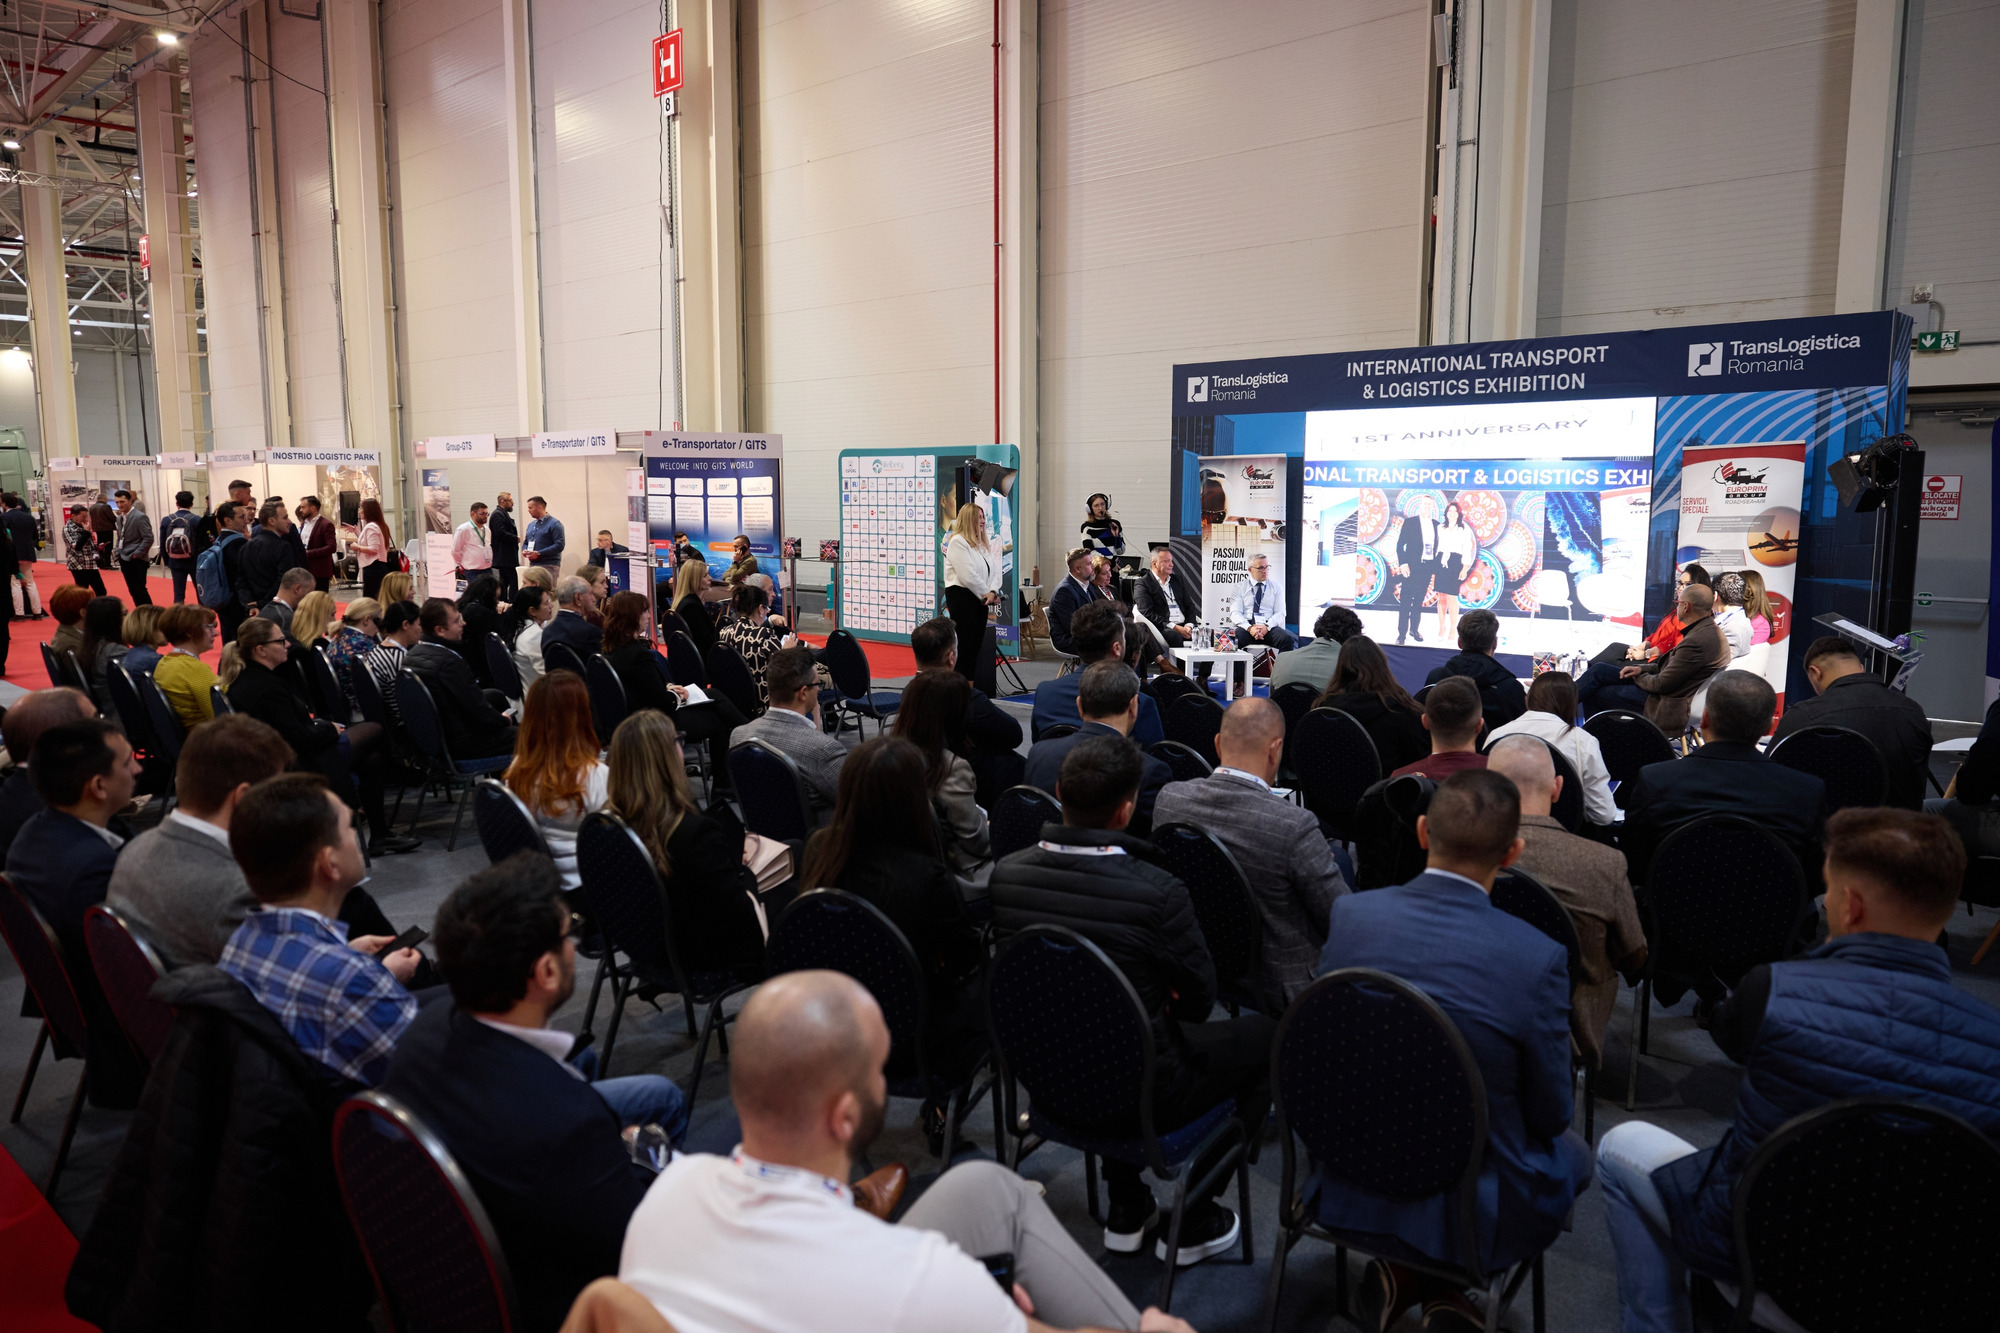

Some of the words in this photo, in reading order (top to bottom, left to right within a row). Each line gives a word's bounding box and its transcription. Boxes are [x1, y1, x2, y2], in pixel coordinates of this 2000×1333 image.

[660, 43, 675, 83] H
[665, 97, 671, 112] 8
[1730, 333, 1861, 356] TransLogistica
[1346, 355, 1486, 377] INTERNATIONAL
[1489, 345, 1609, 370] TRANSPORT
[1728, 355, 1804, 375] Romania
[1212, 371, 1288, 388] TransLogistica
[1362, 384, 1375, 400] &
[1379, 379, 1470, 399] LOGISTICS
[1474, 373, 1585, 394] EXHIBITION
[1210, 388, 1257, 401] Romania
[1352, 433, 1394, 444] 1ST
[1401, 419, 1589, 441] ANNIVERSARY
[445, 441, 472, 451] Group-GTS
[541, 438, 586, 451] e-Transportator
[591, 436, 606, 447] GITS
[662, 438, 736, 451] e-Transportator
[738, 440, 743, 450] /
[745, 440, 767, 450] GITS
[273, 452, 312, 460] INOSTRIO
[354, 453, 375, 461] PARK
[660, 462, 689, 471] WELCOME
[692, 462, 708, 470] INTO
[711, 462, 727, 470] GITS
[730, 460, 754, 469] WORLD
[1304, 466, 1351, 482] ONAL
[1354, 467, 1470, 485] TRANSPORT
[1473, 468, 1489, 485] &
[1493, 468, 1599, 485] LOGISTICS
[1726, 485, 1768, 493] EUROPRIM
[1682, 497, 1707, 506] SERVICII
[1682, 505, 1709, 514] SPECIALE
[1213, 547, 1245, 558] PASSION
[1212, 560, 1227, 571] FOR
